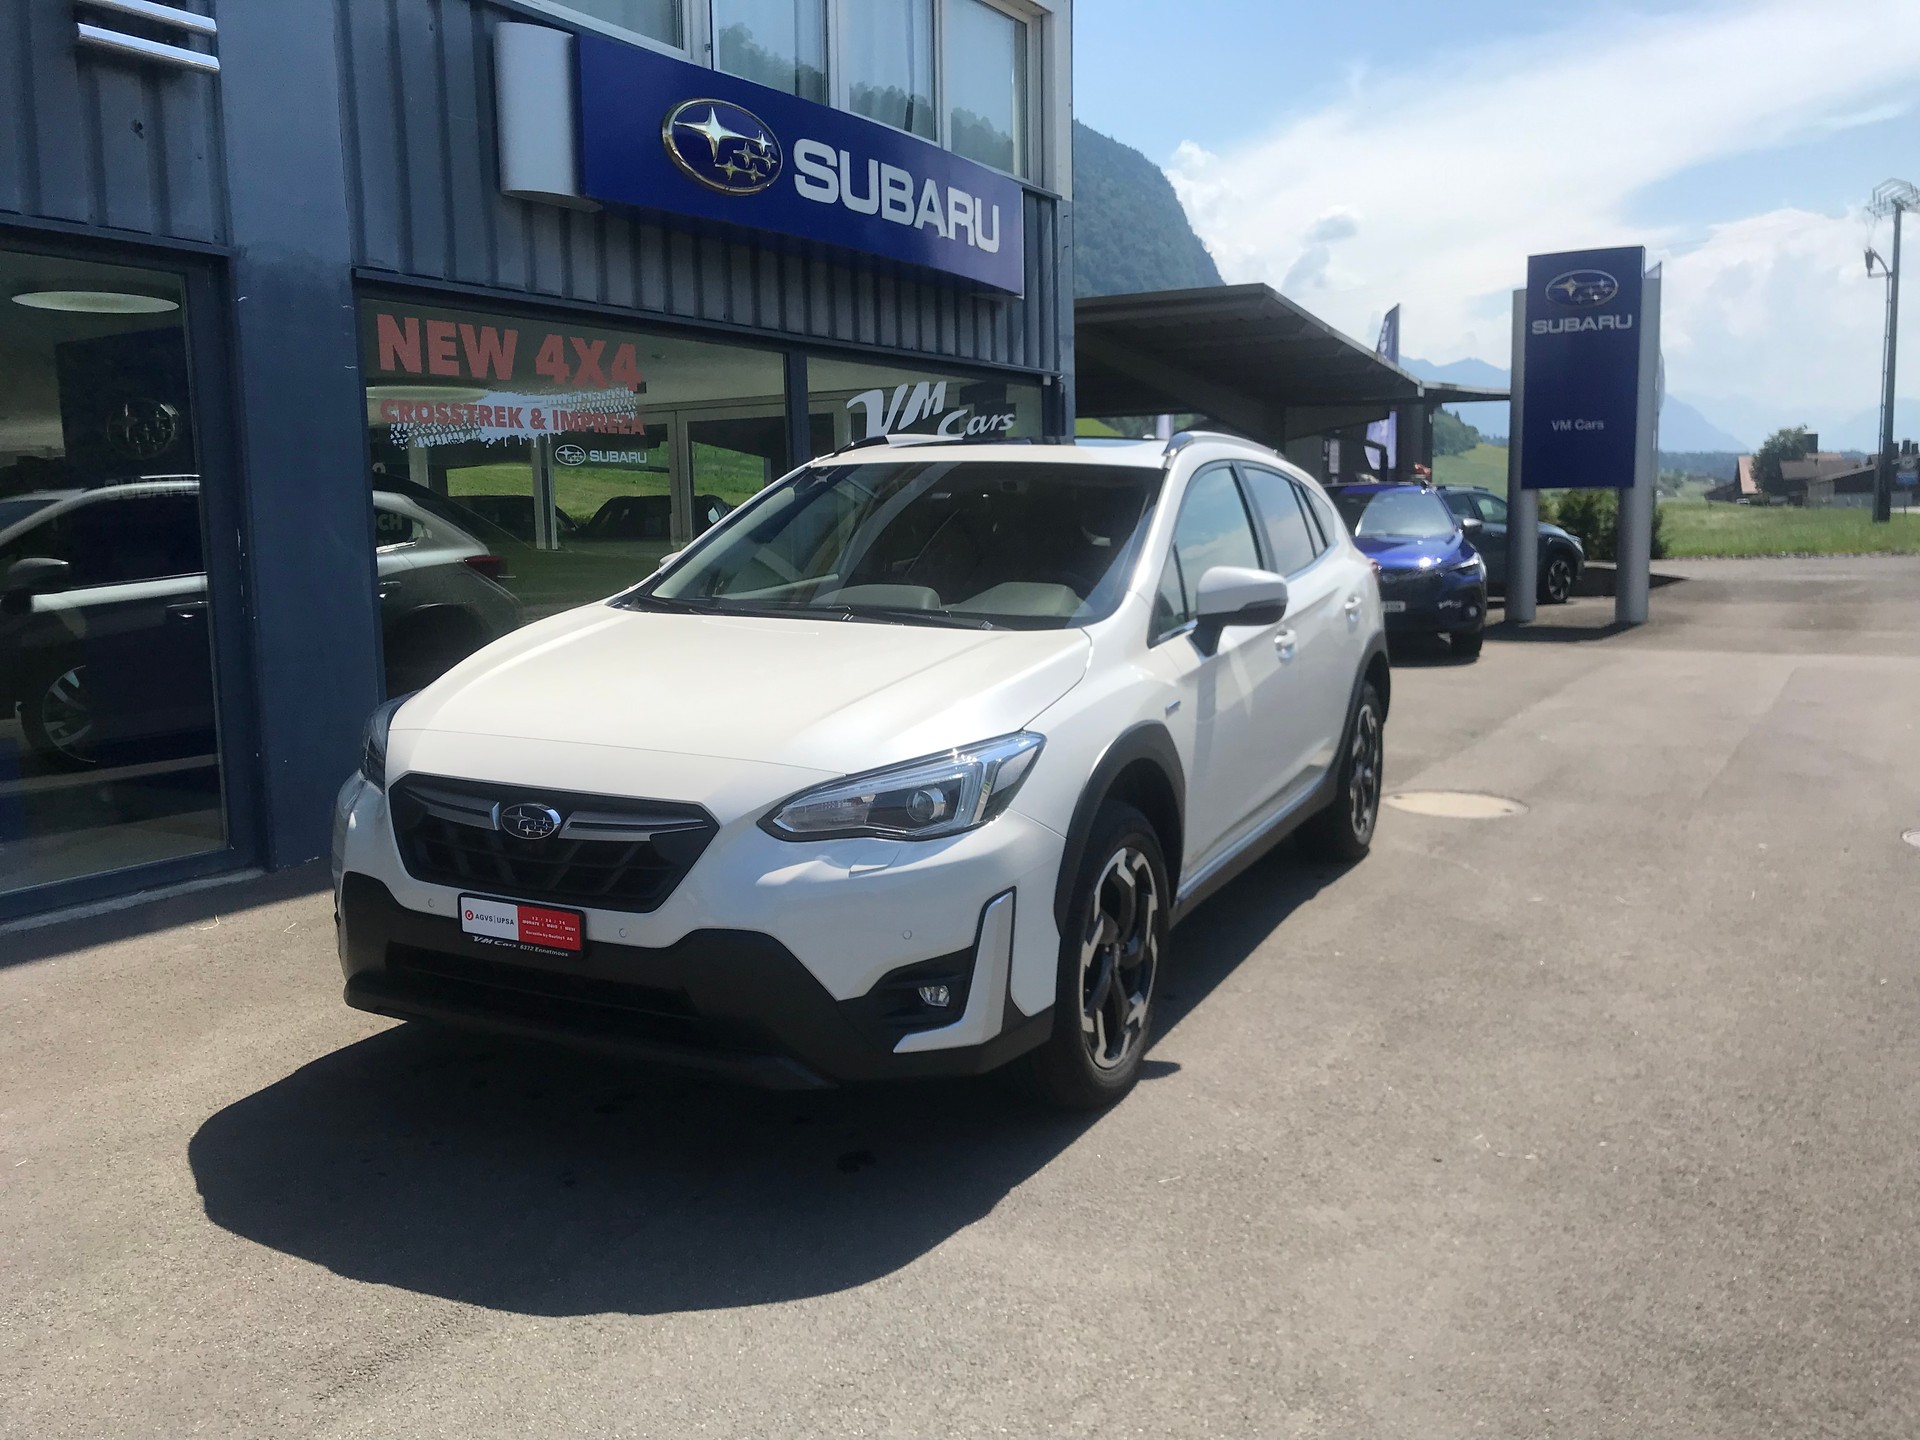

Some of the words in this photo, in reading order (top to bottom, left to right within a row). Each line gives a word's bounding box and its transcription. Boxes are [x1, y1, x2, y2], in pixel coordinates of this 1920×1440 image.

[793, 138, 1001, 254] SUBARU
[1531, 313, 1633, 336] SUBARU
[376, 313, 519, 381] NEW
[535, 334, 643, 392] 4X4
[380, 398, 525, 430] CROSSTREK
[529, 406, 547, 430] &
[552, 408, 646, 436] IMPREZA
[846, 380, 948, 438] VM
[937, 409, 1016, 439] Cars
[1551, 419, 1572, 432] VM
[1574, 418, 1605, 431] Cars
[589, 449, 648, 465] SUBARU
[475, 913, 493, 923] AGVS
[496, 917, 515, 927] UPSA
